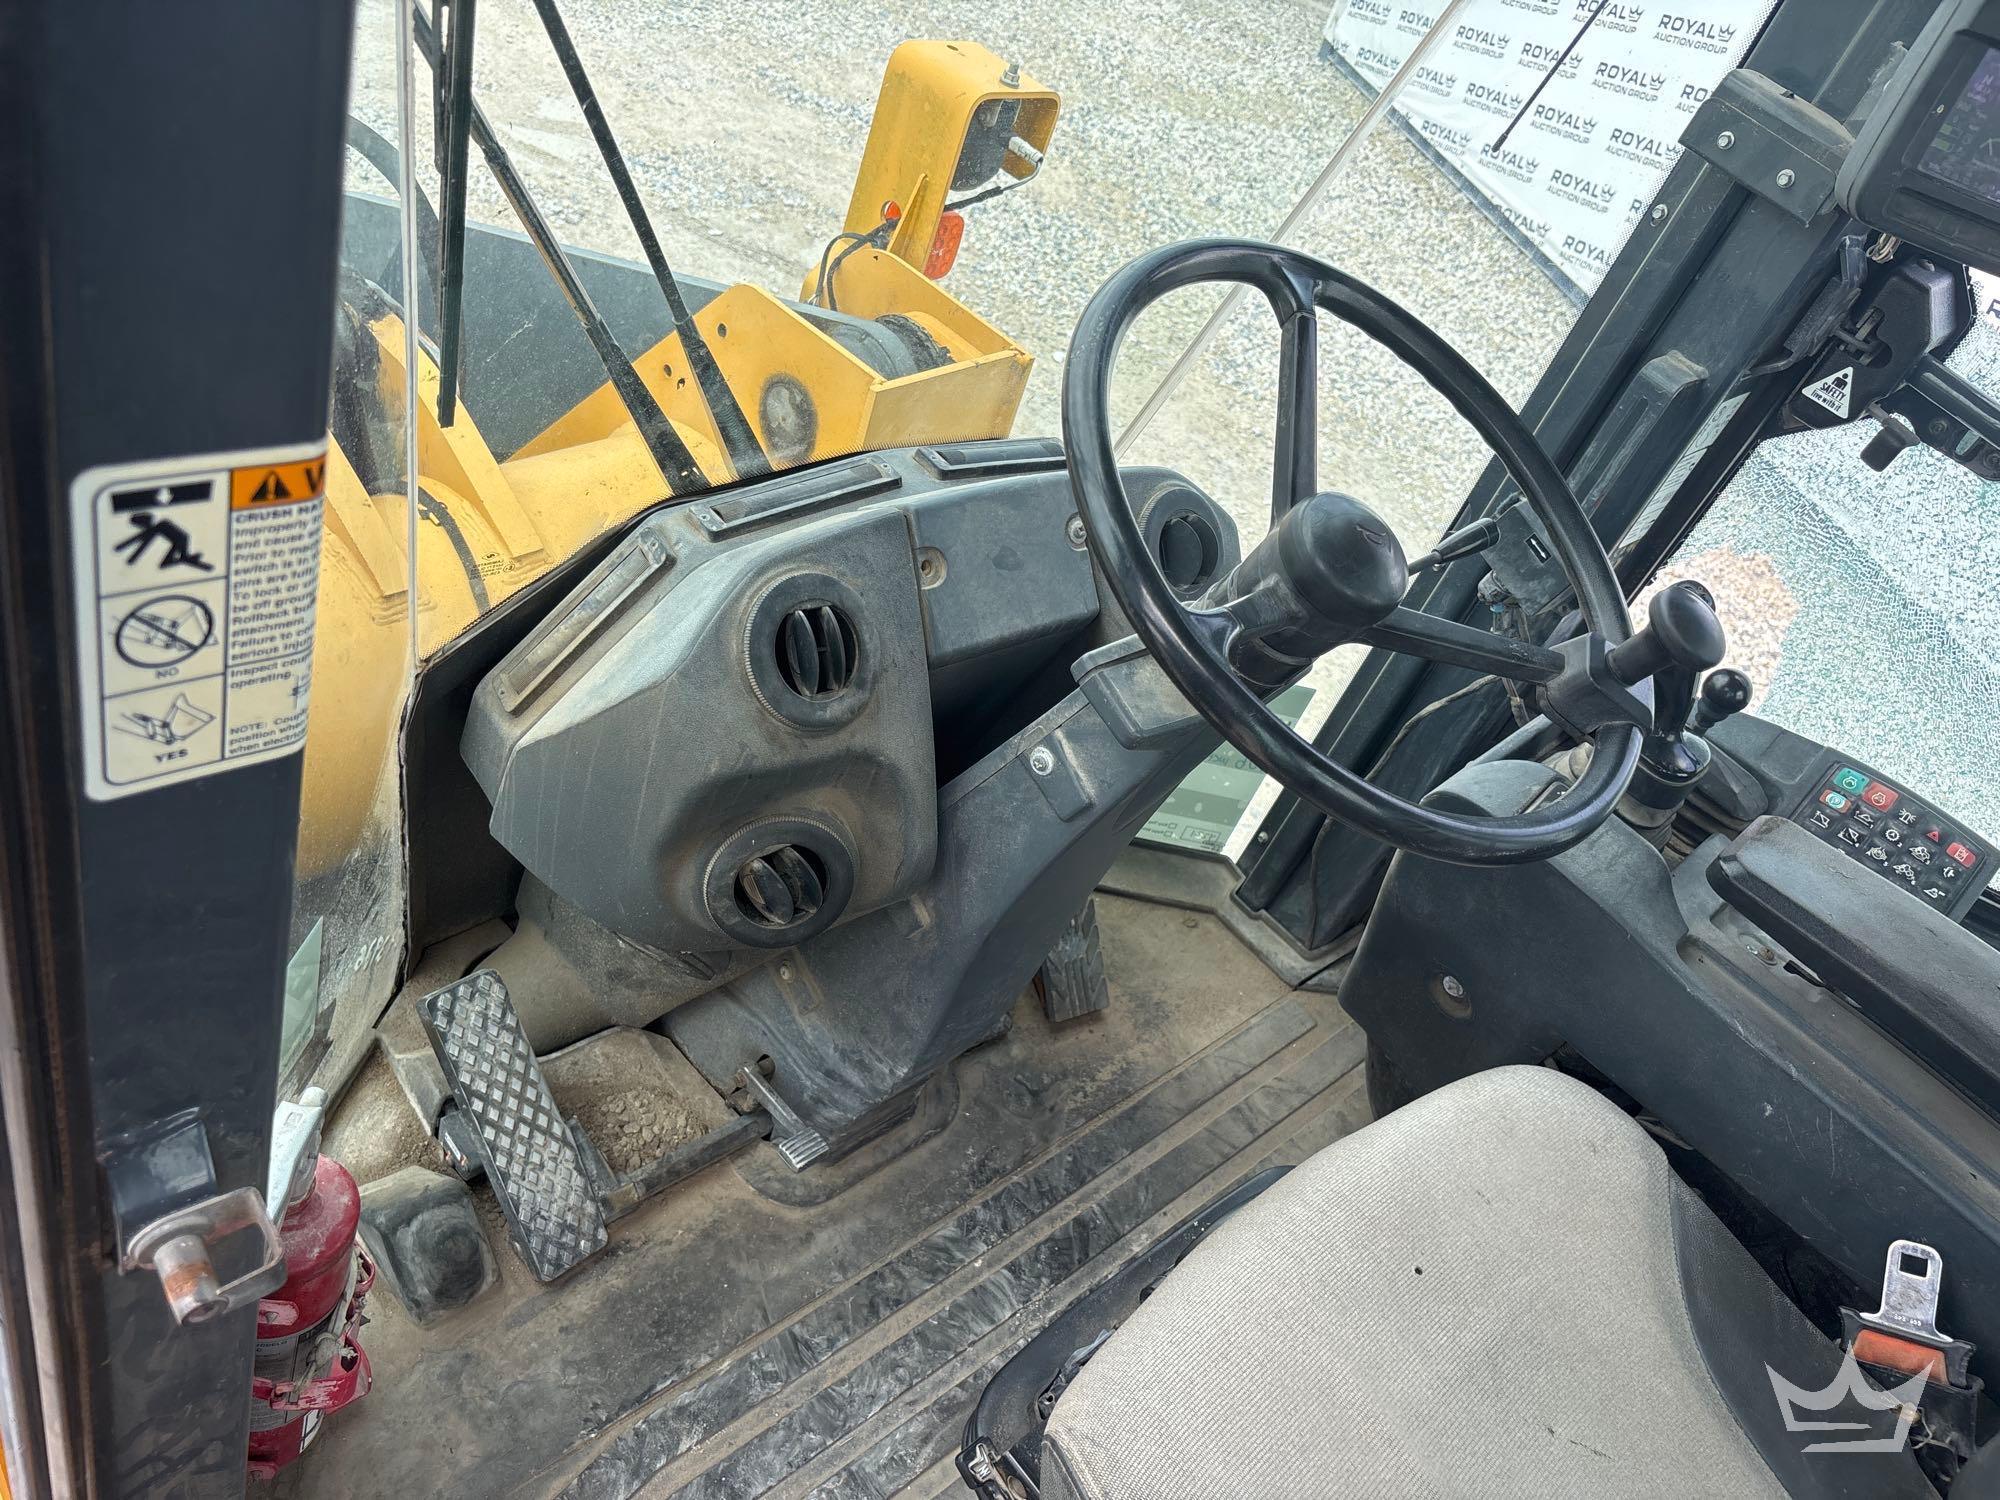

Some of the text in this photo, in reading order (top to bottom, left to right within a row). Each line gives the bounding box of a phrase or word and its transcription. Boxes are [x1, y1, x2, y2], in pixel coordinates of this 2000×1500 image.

[1350, 0, 1381, 15] ROYAL
[1456, 25, 1496, 46] ROYAL
[1607, 22, 1637, 34] GROUP
[1657, 14, 1715, 39] ROYAL
[1653, 31, 1728, 55] AUCTION GROUP
[1357, 47, 1389, 67] ROYAL
[1416, 67, 1444, 85] OYAL
[1596, 61, 1647, 88] ROYAL
[1465, 83, 1508, 107] ROYAL
[1591, 78, 1659, 103] AUCTION GROUP
[1533, 104, 1581, 130] ROYAL
[1421, 120, 1457, 144] ROYAL
[1530, 119, 1590, 144] AUCTION GROUP
[1609, 128, 1662, 157] ROYAL
[1605, 145, 1642, 166] AUCTION
[1550, 169, 1599, 199] ROYAL
[1546, 185, 1579, 204] AUCTION
[1579, 196, 1609, 213] GROUP
[1810, 389, 1822, 401] live
[1821, 397, 1836, 409] with
[1820, 382, 1846, 401] SAFETY
[235, 508, 293, 524] CRUSH
[235, 519, 310, 537] Improperly
[235, 539, 261, 551] and
[264, 533, 305, 546] cause
[234, 551, 268, 564] Prior
[271, 549, 286, 559] to
[234, 562, 278, 577] switch
[283, 560, 294, 570] is
[233, 577, 261, 592] pins
[266, 573, 288, 584] are
[233, 590, 251, 602] To
[255, 585, 282, 598] lock
[286, 583, 299, 593] or
[232, 603, 250, 614] be
[232, 608, 289, 626] Rollback
[232, 631, 293, 650] Failure to
[231, 645, 280, 661] serious
[155, 667, 179, 680] NO
[230, 661, 278, 678] Inspect
[230, 729, 277, 747] position
[154, 748, 188, 762] YES
[229, 742, 260, 755] when
